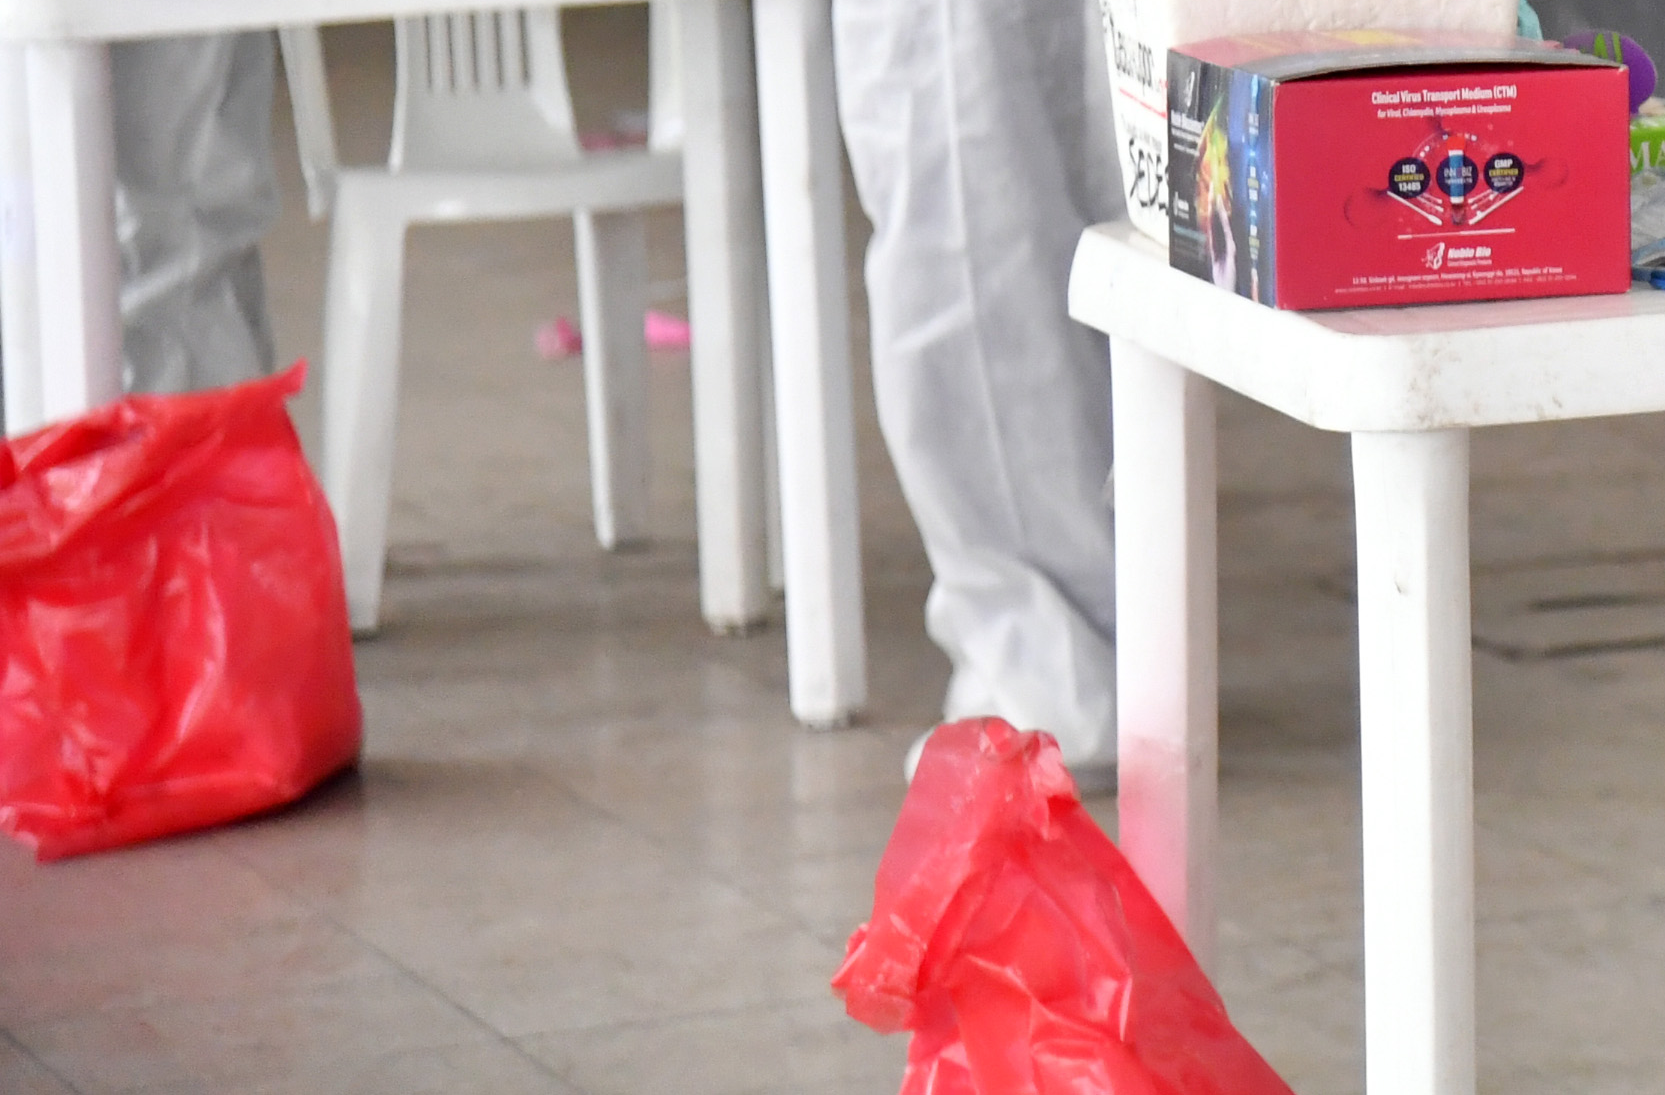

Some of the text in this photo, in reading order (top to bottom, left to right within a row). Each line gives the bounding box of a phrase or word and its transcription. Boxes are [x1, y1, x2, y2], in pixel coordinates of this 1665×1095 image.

[1371, 84, 1518, 104] Clinical Virus Transport Medium (CTM)
[1377, 108, 1386, 118] for
[1402, 164, 1416, 174] ISO
[1494, 158, 1513, 169] GMP
[1128, 136, 1169, 216] SEDE
